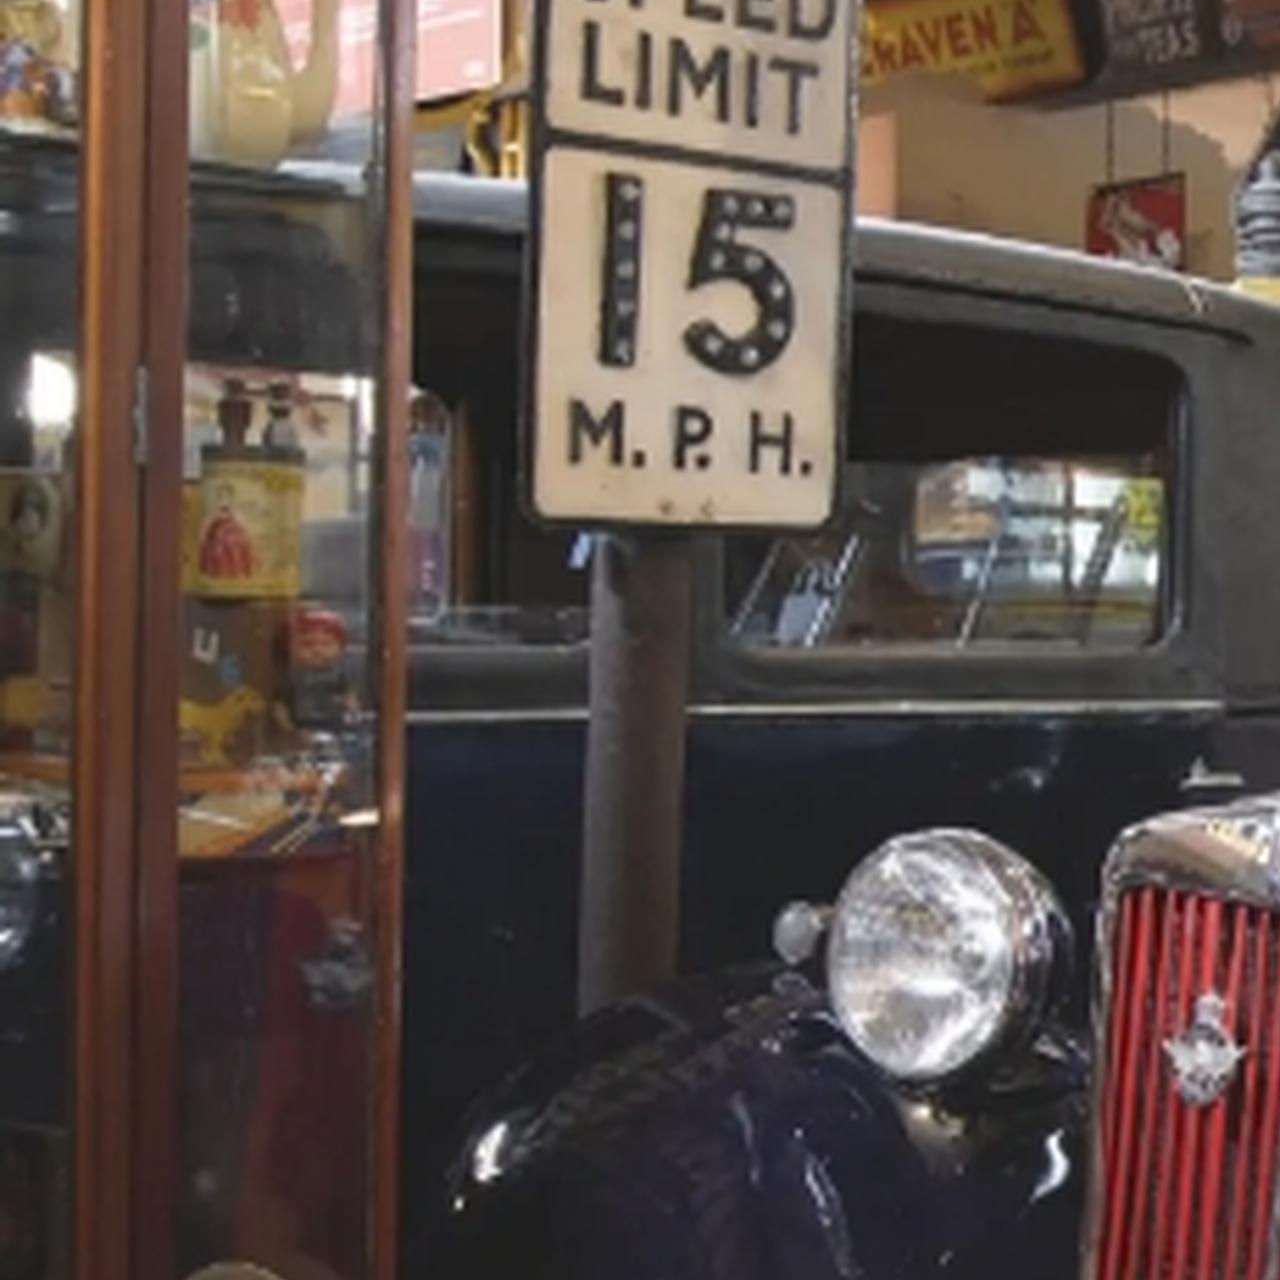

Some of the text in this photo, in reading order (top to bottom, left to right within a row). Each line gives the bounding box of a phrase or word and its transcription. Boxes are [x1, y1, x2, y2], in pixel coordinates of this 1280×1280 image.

[580, 19, 819, 136] LIMIT
[860, 4, 999, 77] RAVEN
[597, 171, 797, 377] 15
